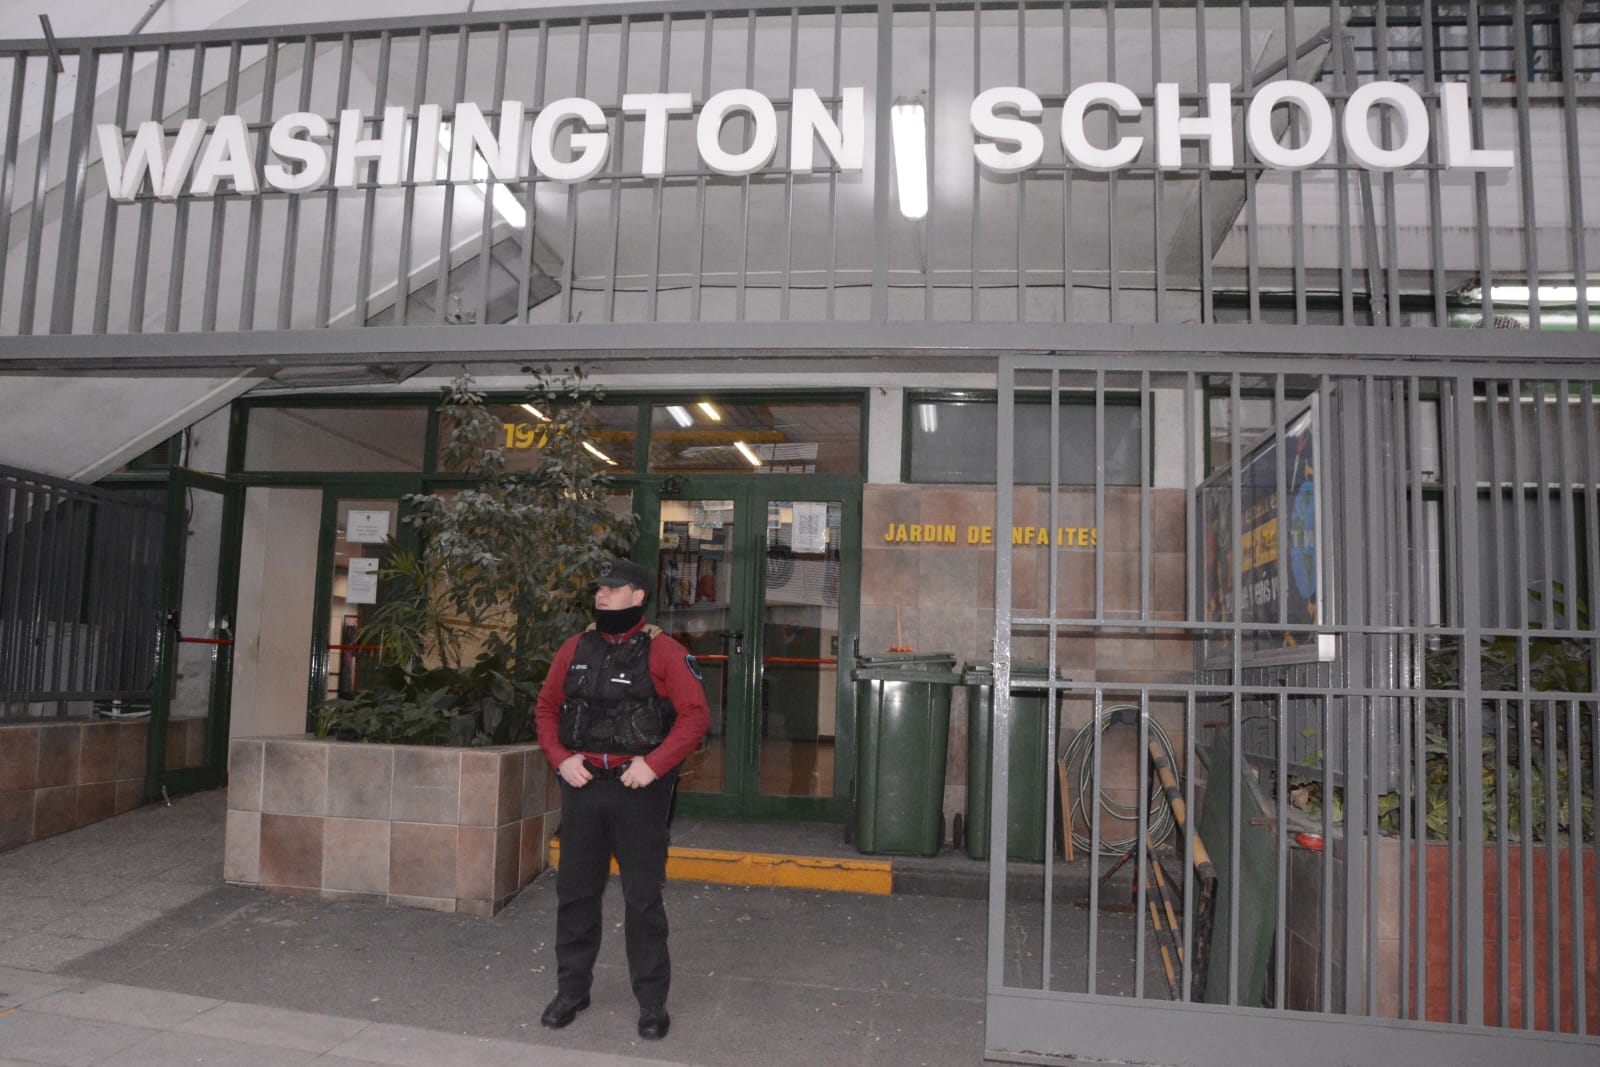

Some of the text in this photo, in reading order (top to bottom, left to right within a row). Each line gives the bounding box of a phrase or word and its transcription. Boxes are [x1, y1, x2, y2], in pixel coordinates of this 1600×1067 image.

[97, 80, 1514, 203] WASHINGTON SCHOOL
[503, 422, 571, 449] 197
[884, 522, 1098, 546] JARDIN DE NFATES
